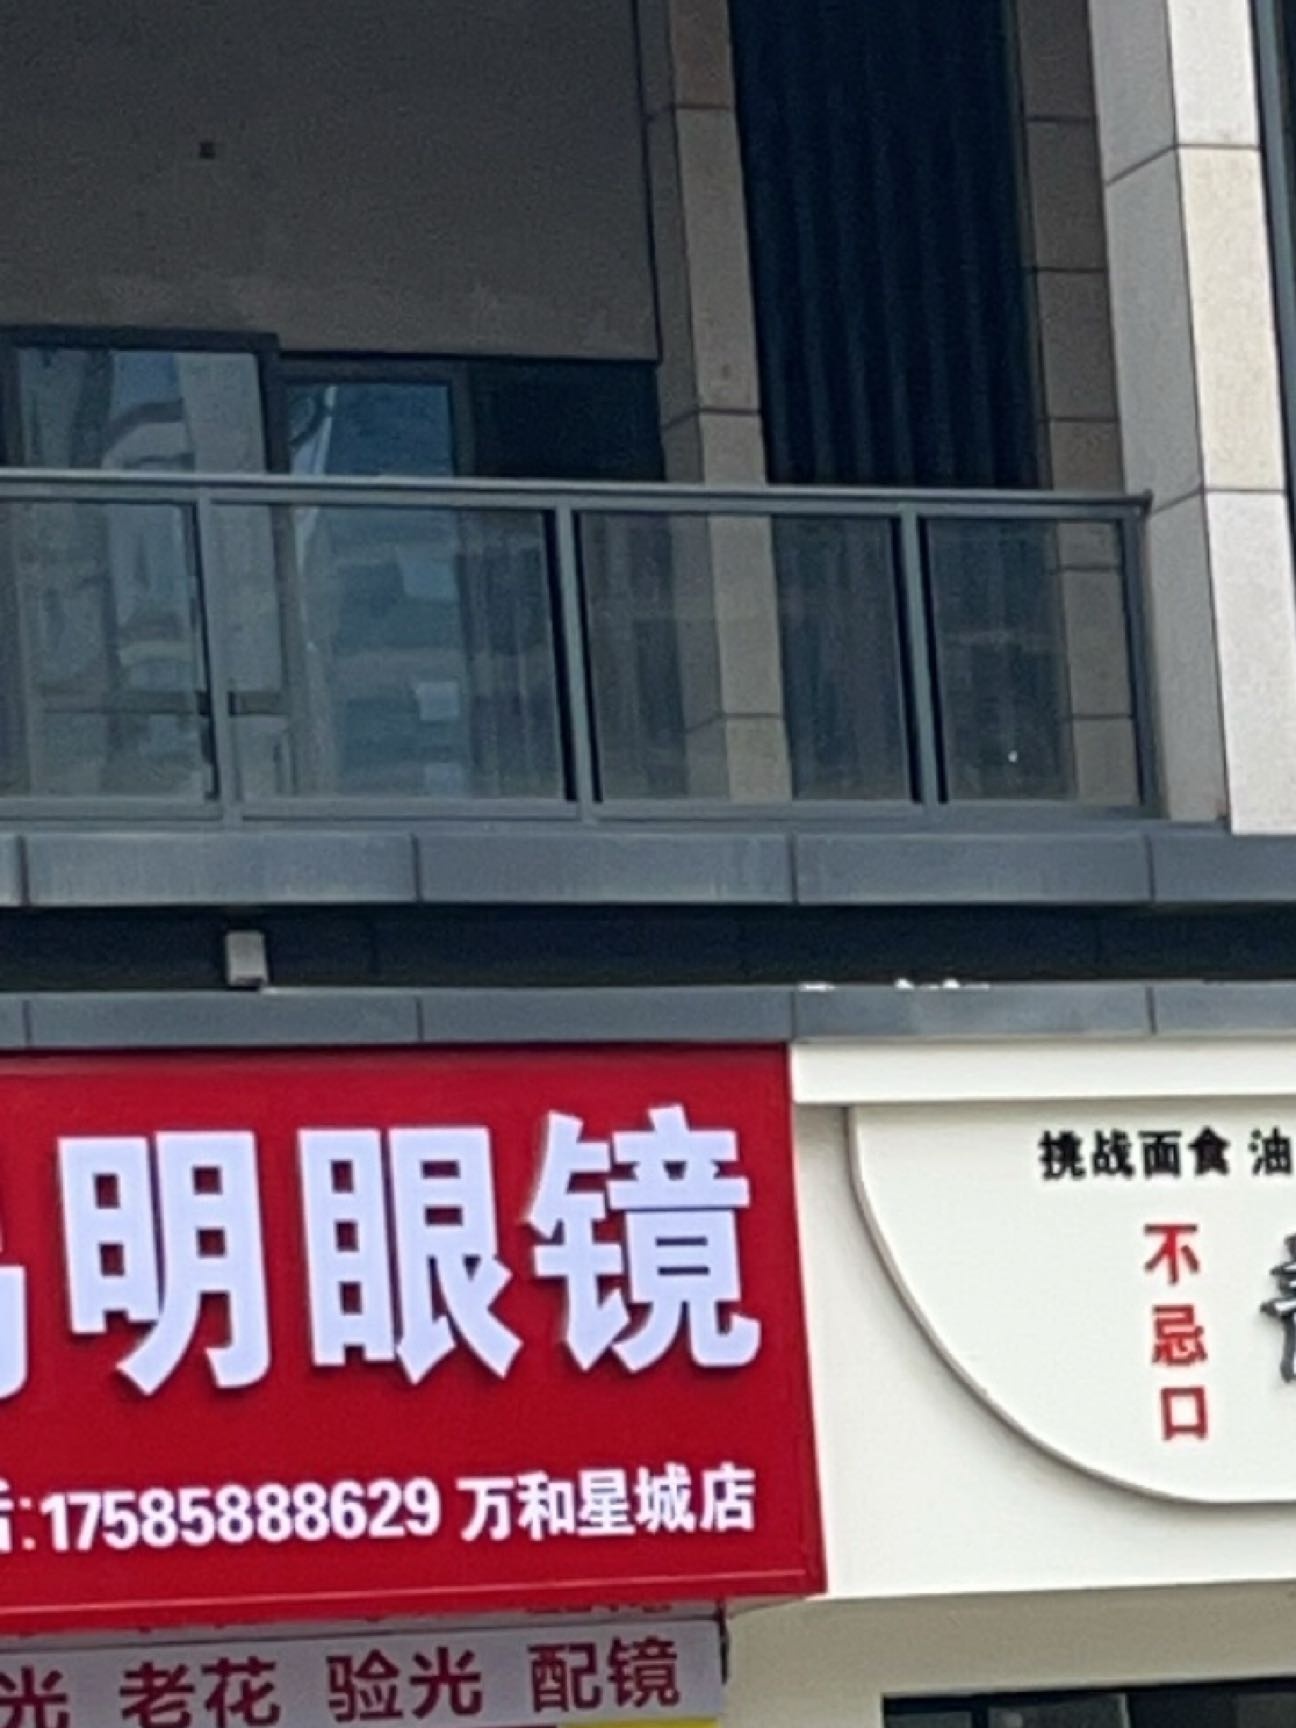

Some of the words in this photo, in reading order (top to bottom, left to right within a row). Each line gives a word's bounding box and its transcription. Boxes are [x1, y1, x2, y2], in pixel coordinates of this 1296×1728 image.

[1039, 1127, 1231, 1181] 挑战面食
[1144, 1222, 1208, 1441] 不忌口
[0, 1478, 442, 1553] :17585888629
[456, 1461, 756, 1541] 万和星城店
[328, 1647, 484, 1723] 验光
[527, 1635, 680, 1713] 配镜
